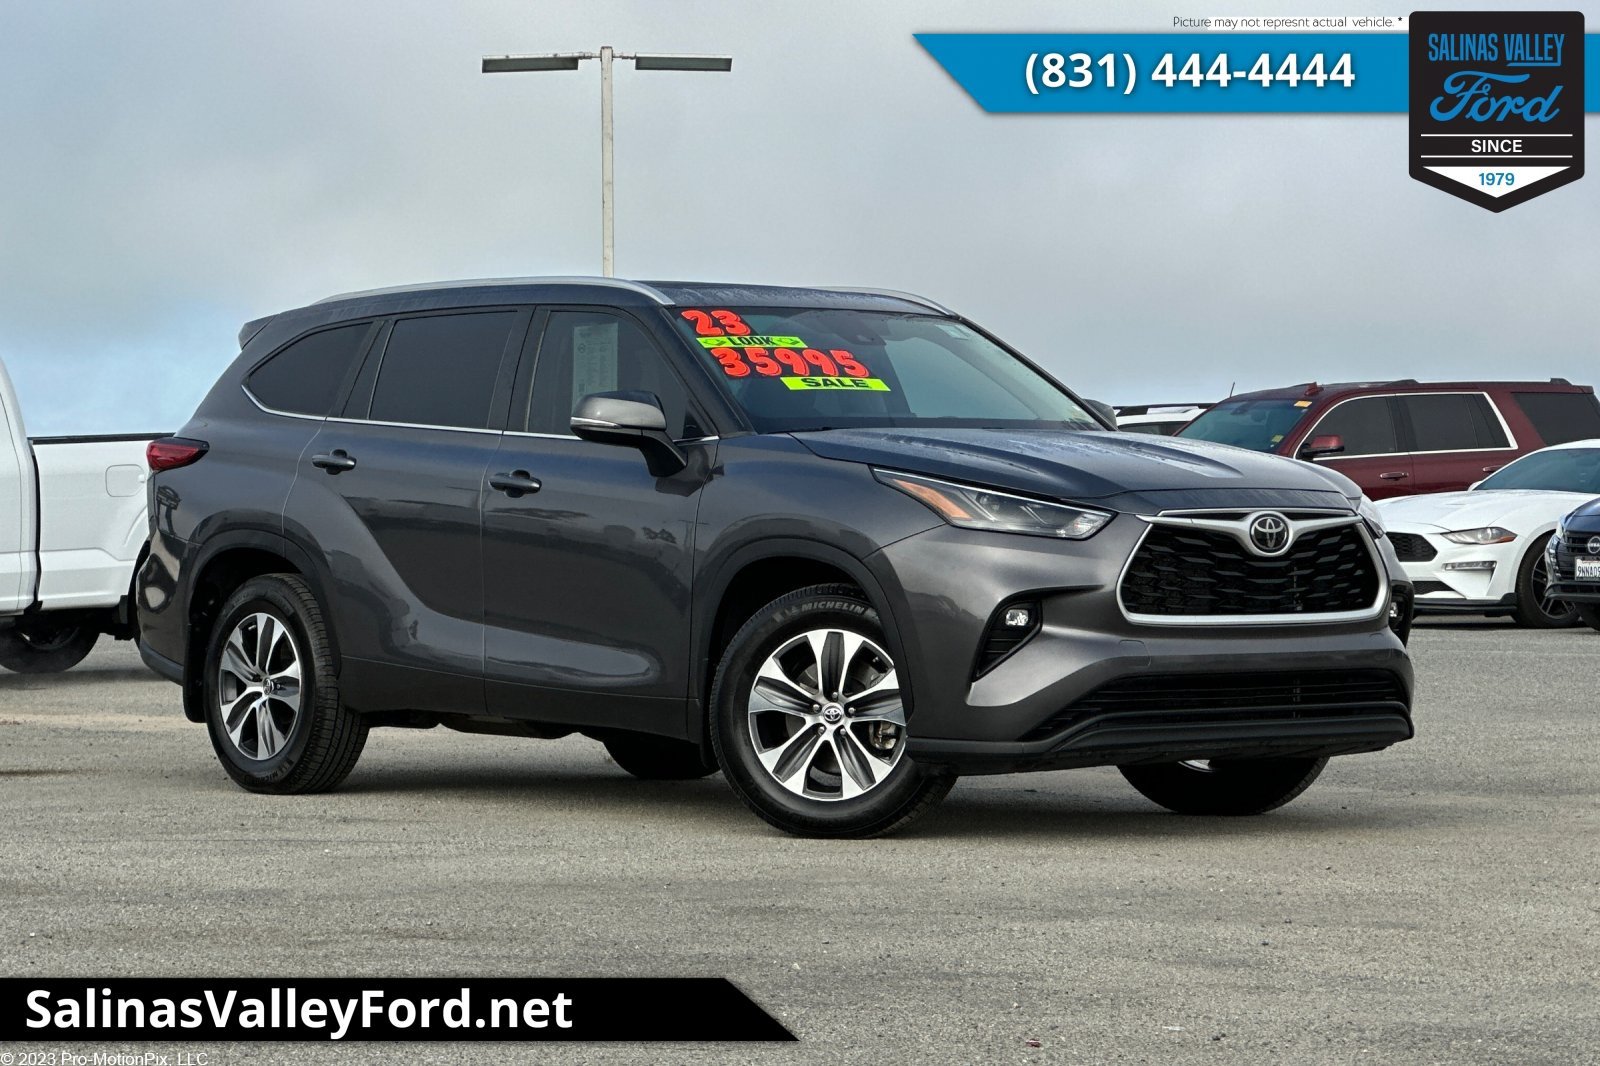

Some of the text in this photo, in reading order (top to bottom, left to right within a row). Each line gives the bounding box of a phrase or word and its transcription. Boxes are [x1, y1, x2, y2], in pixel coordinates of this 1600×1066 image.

[681, 309, 750, 336] 23
[727, 336, 775, 347] LOOK
[710, 347, 870, 378] 35995
[801, 377, 872, 389] SALE
[801, 601, 865, 614] MICHELIN
